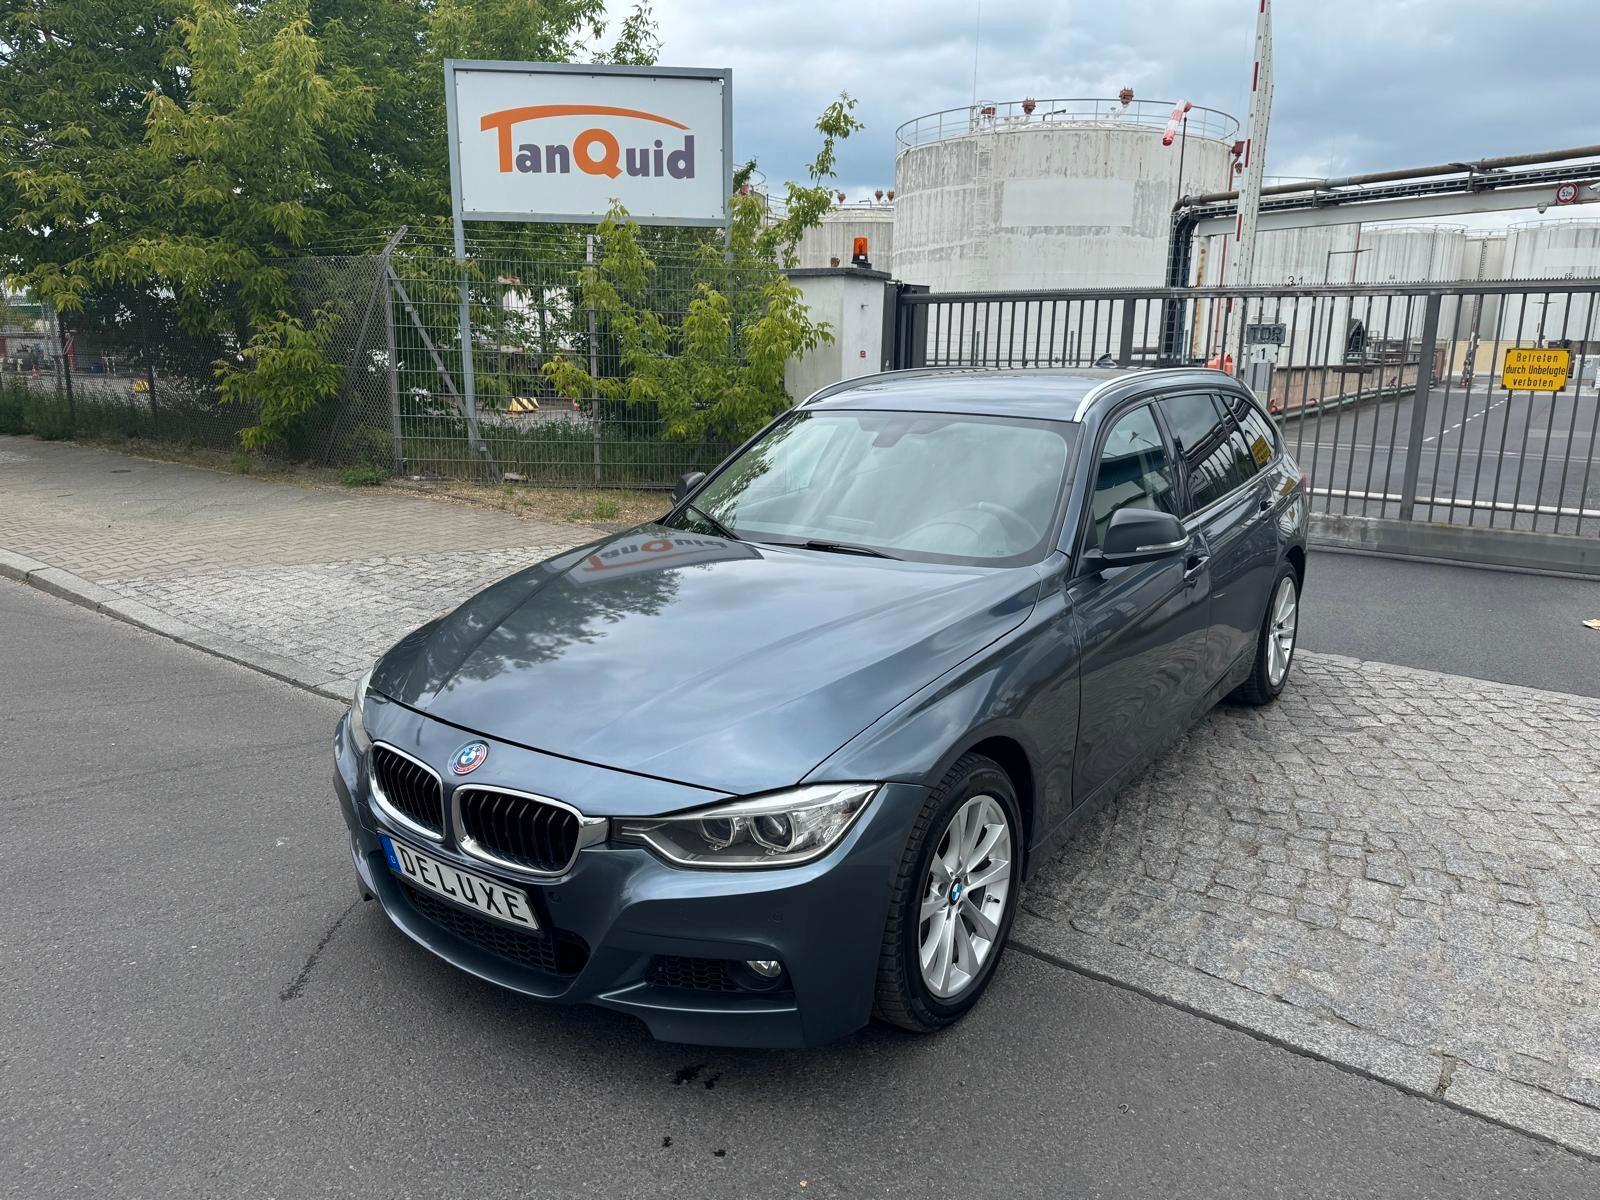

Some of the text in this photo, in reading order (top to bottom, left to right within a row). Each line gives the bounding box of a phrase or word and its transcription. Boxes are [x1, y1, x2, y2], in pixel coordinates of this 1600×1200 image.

[480, 104, 695, 180] TanQuid
[1516, 352, 1559, 363] Betreten
[1505, 364, 1567, 378] durch Unbefugte
[1513, 376, 1554, 387] verboten
[397, 845, 529, 924] DELUXE
